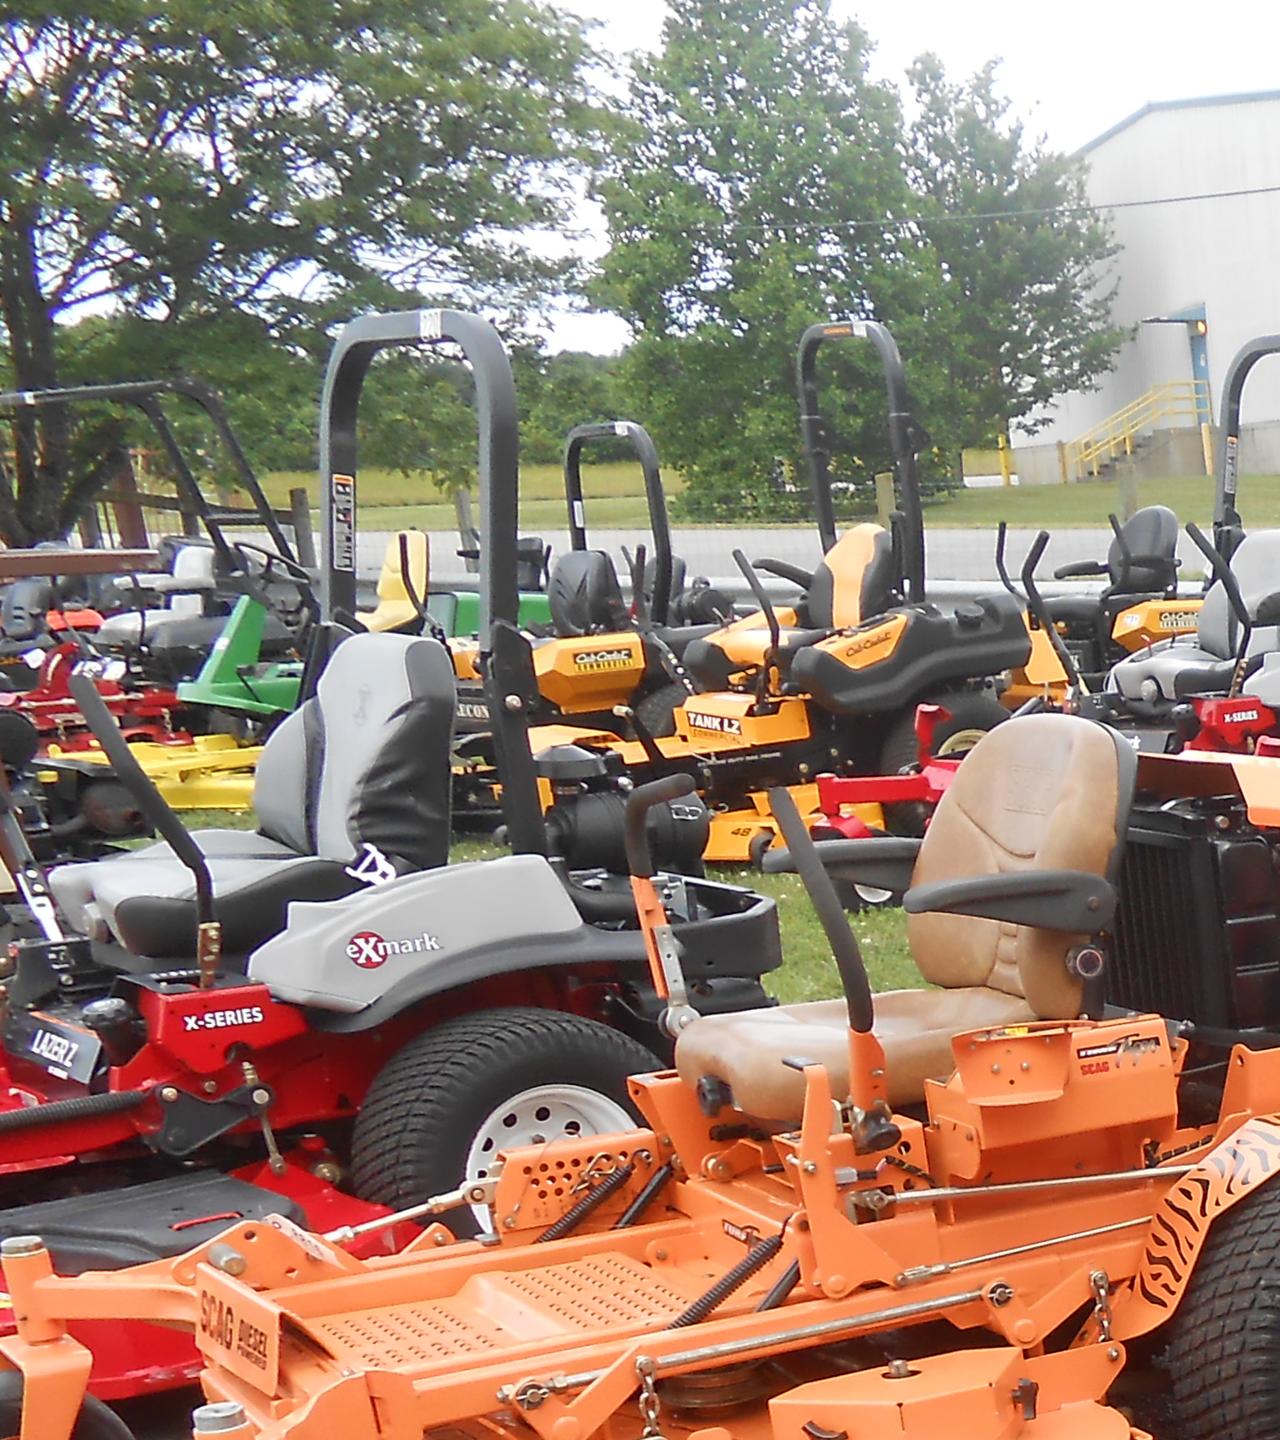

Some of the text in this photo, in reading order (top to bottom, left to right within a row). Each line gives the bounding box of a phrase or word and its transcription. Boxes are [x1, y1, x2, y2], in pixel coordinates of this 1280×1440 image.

[688, 712, 740, 734] TANK LZ
[345, 931, 440, 969] eXmark
[183, 1007, 264, 1032] X-SERIES
[31, 1029, 79, 1068] LAZER Z
[201, 1289, 267, 1358] SCAG DIESEL
